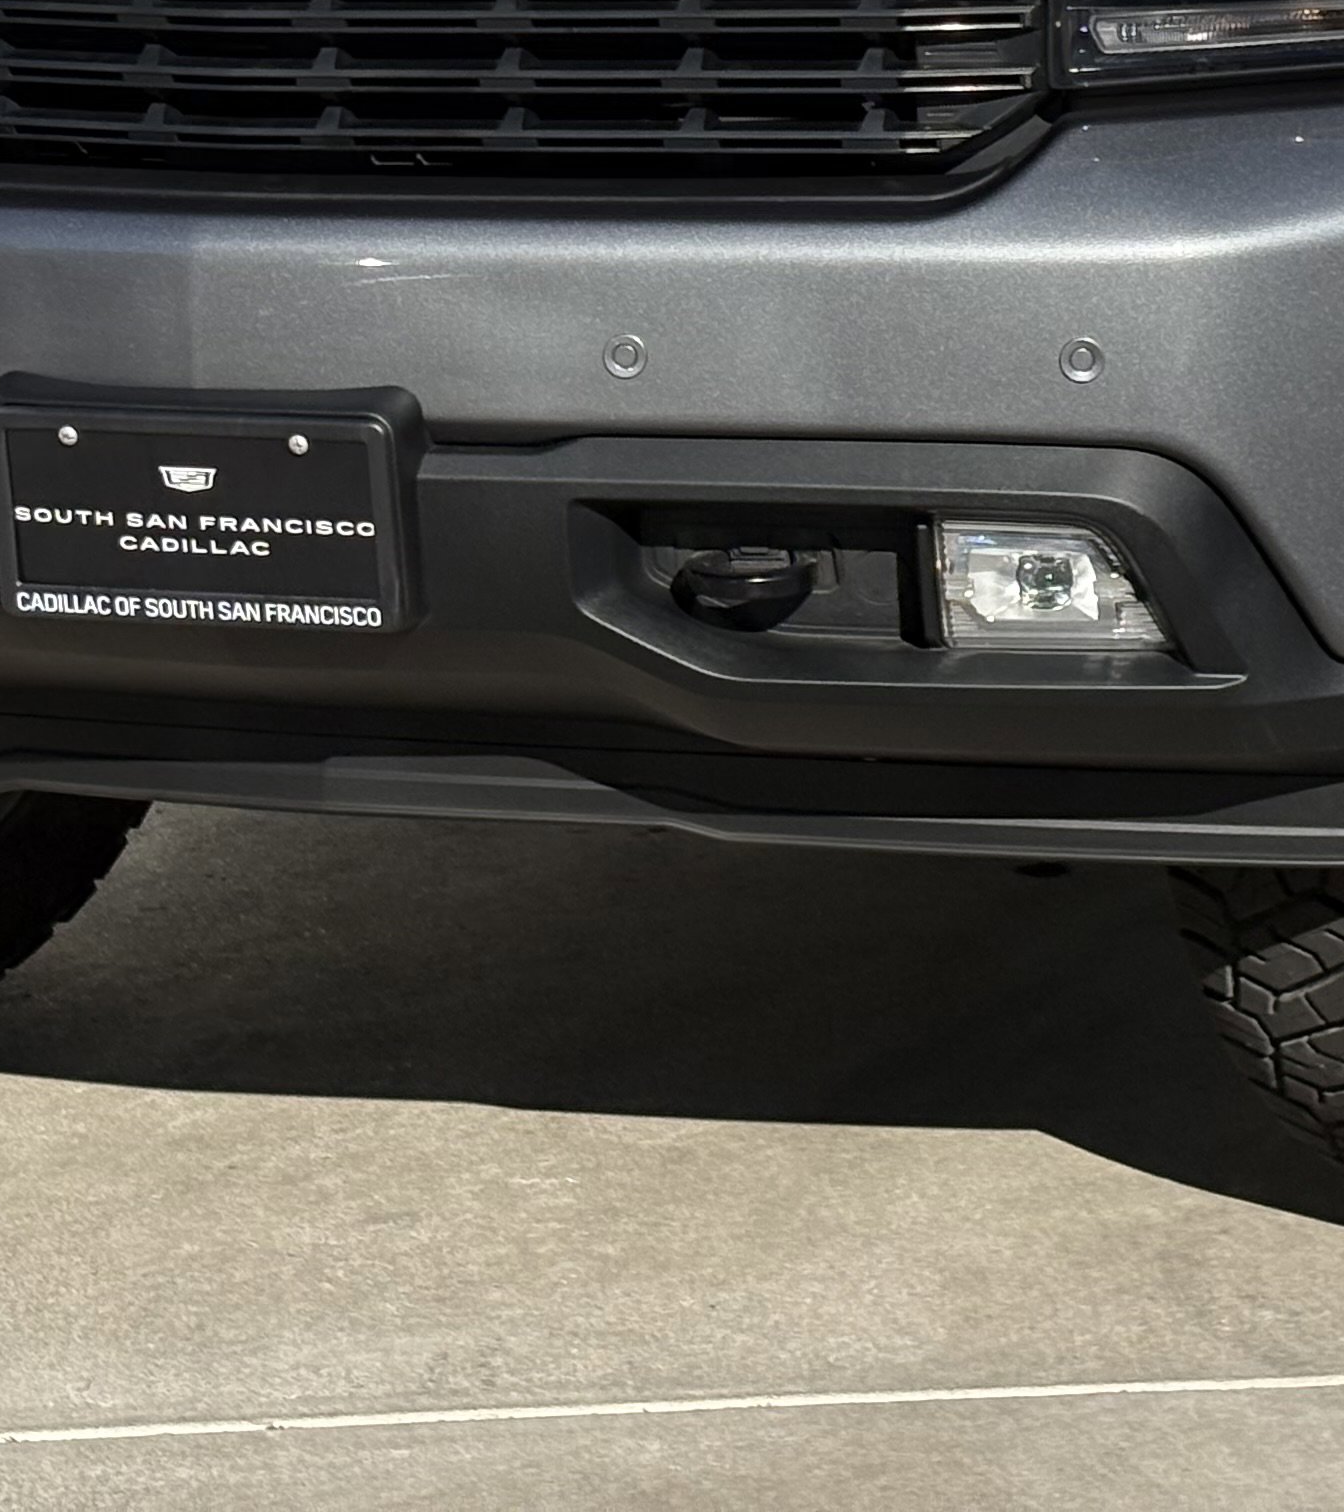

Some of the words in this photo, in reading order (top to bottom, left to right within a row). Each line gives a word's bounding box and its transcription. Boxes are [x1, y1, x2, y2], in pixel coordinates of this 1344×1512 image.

[13, 506, 114, 527] SOUTH
[125, 512, 188, 530] SAN
[199, 515, 376, 537] FRANCISCO
[118, 535, 271, 557] CADILLAC
[15, 591, 112, 617] CADILLAC
[113, 595, 142, 617] OF
[143, 597, 215, 621] SOUTH
[217, 600, 262, 623] SAN
[264, 602, 382, 627] FRANCISCO
